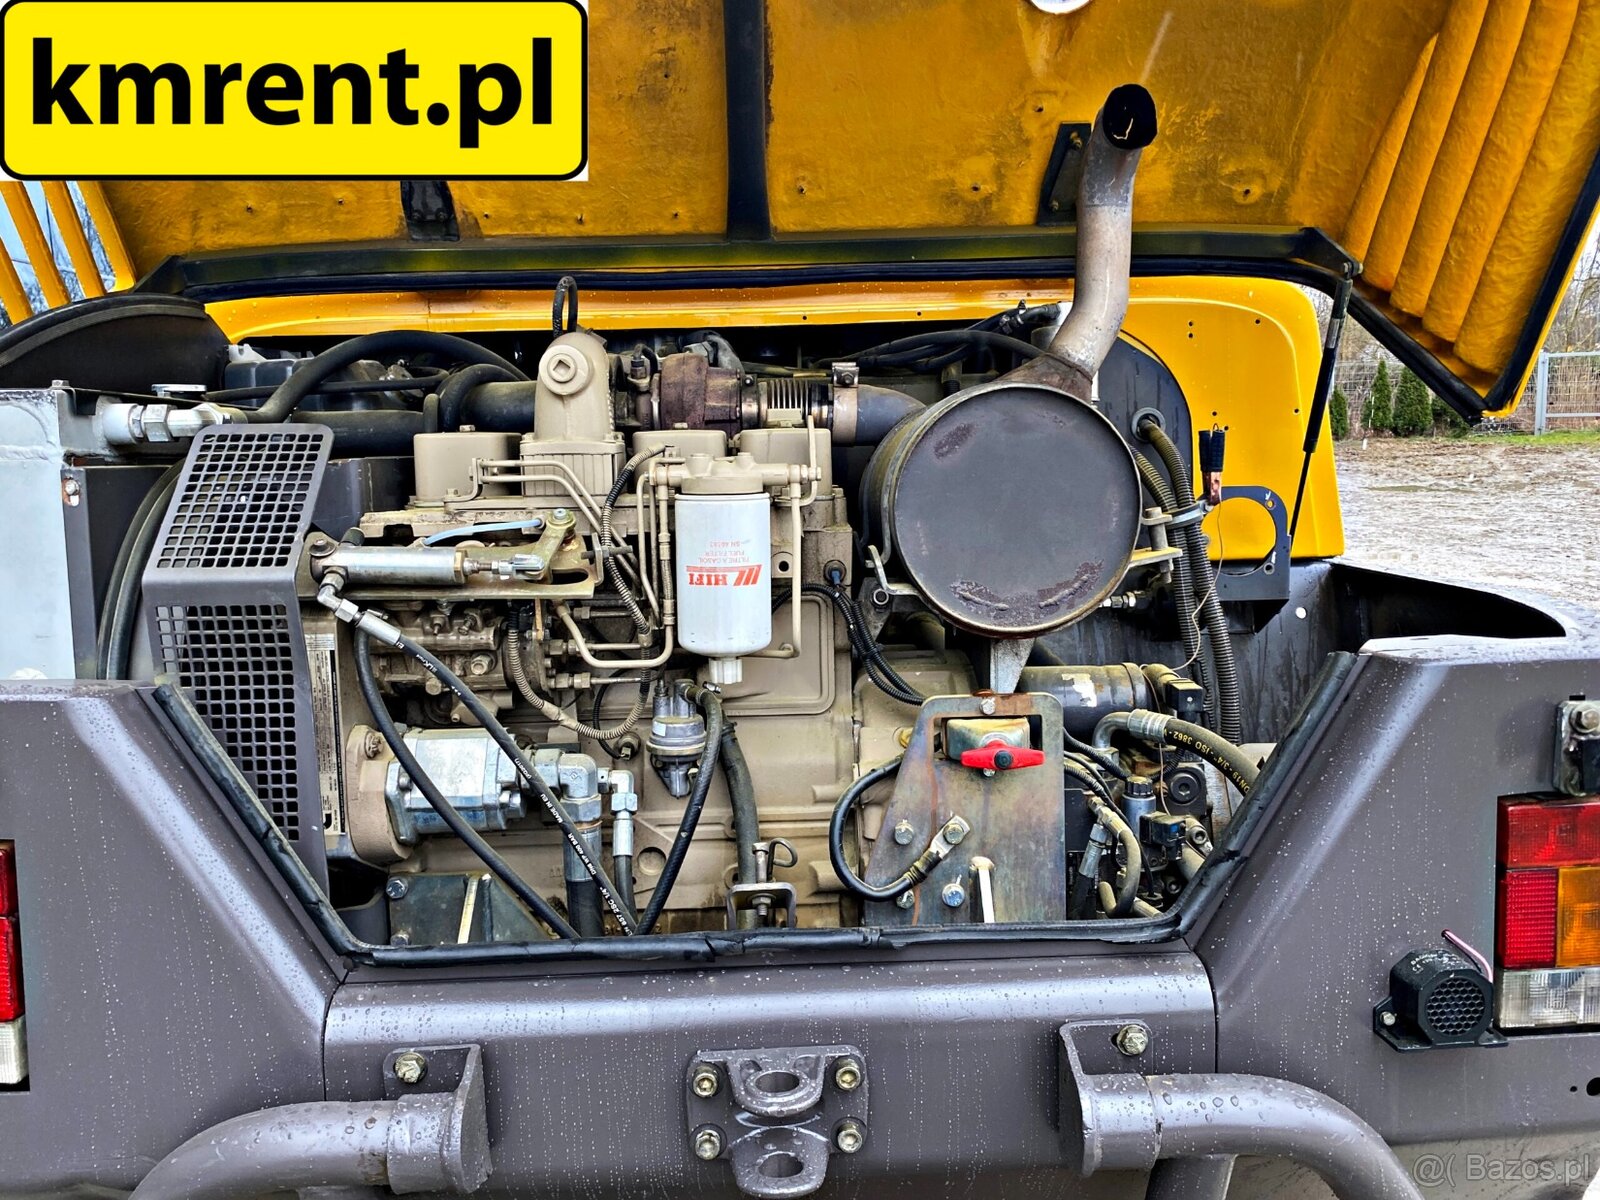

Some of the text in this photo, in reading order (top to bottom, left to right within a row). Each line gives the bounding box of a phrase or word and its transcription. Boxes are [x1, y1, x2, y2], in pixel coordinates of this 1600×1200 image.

[688, 573, 728, 585] HIFI
[1173, 730, 1193, 745] 3862
[1194, 741, 1210, 755] ISO
[1232, 771, 1251, 794] DN19
[540, 793, 563, 824] MADE IN EU
[568, 833, 578, 846] BAR
